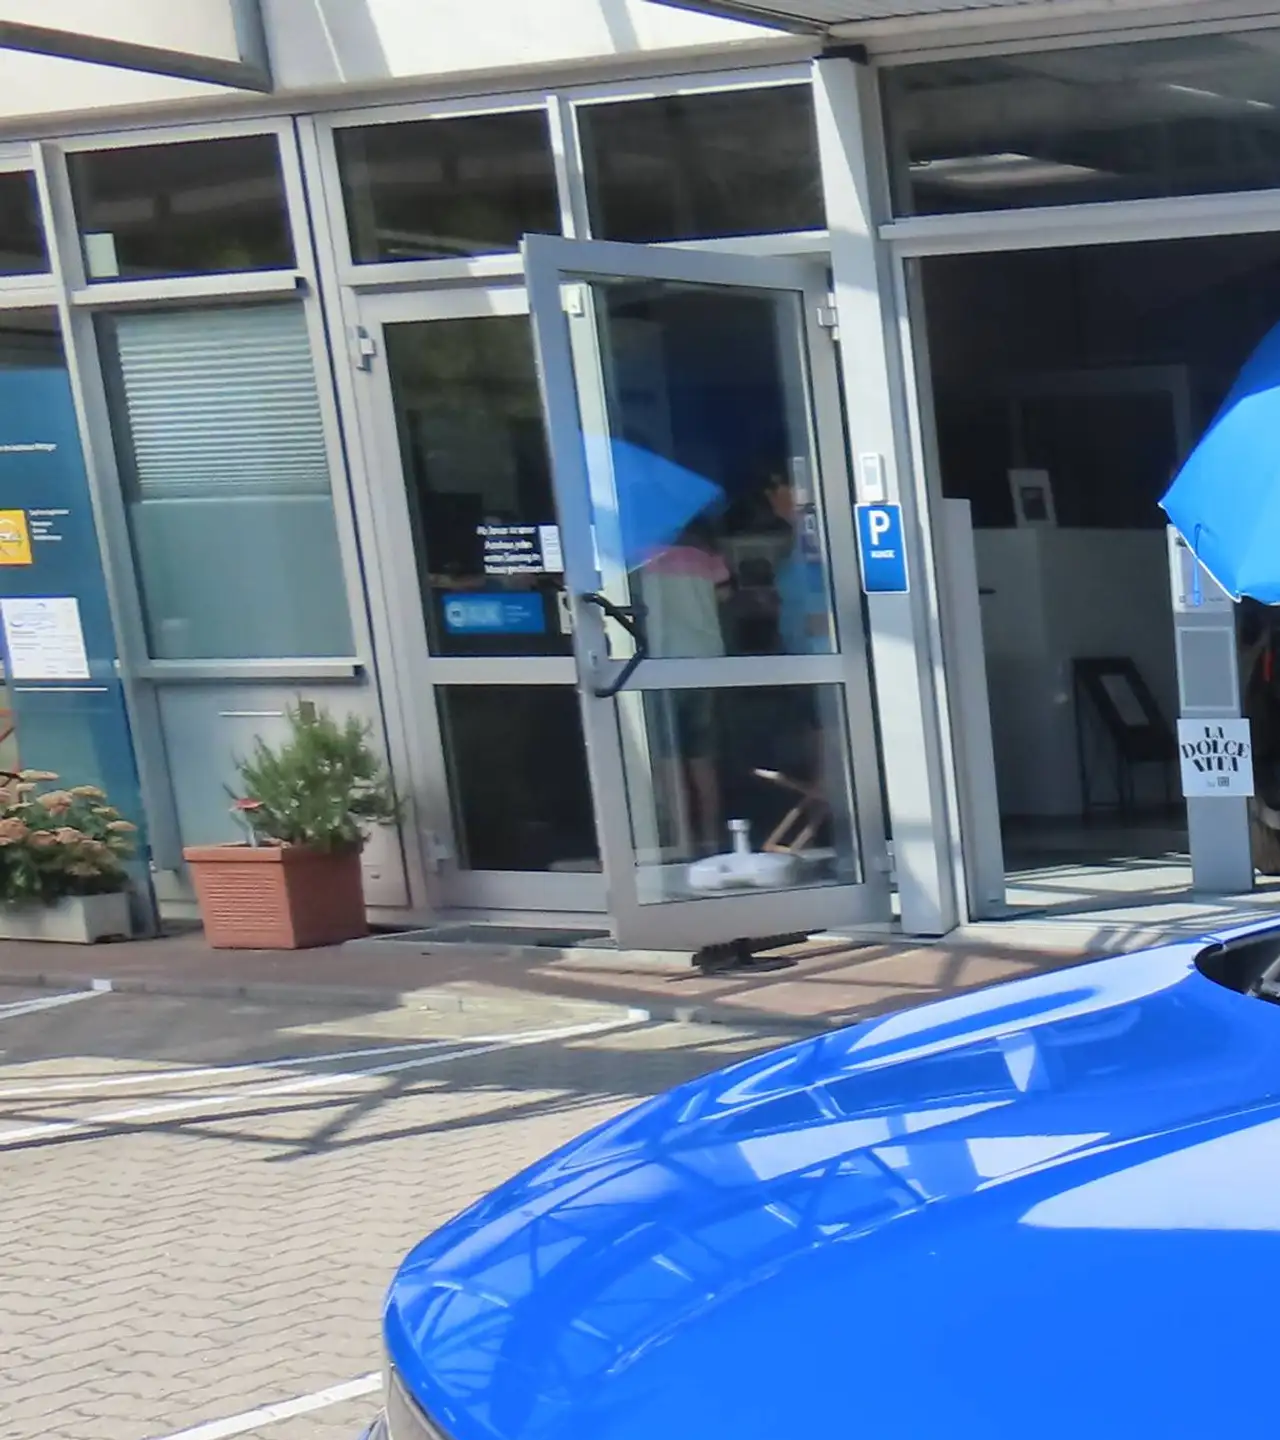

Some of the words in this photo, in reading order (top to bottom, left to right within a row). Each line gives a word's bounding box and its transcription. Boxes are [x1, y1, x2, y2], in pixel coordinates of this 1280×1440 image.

[868, 509, 891, 546] P
[1204, 726, 1224, 740] LA
[1181, 739, 1250, 759] DOLCE
[1192, 755, 1239, 773] VITA
